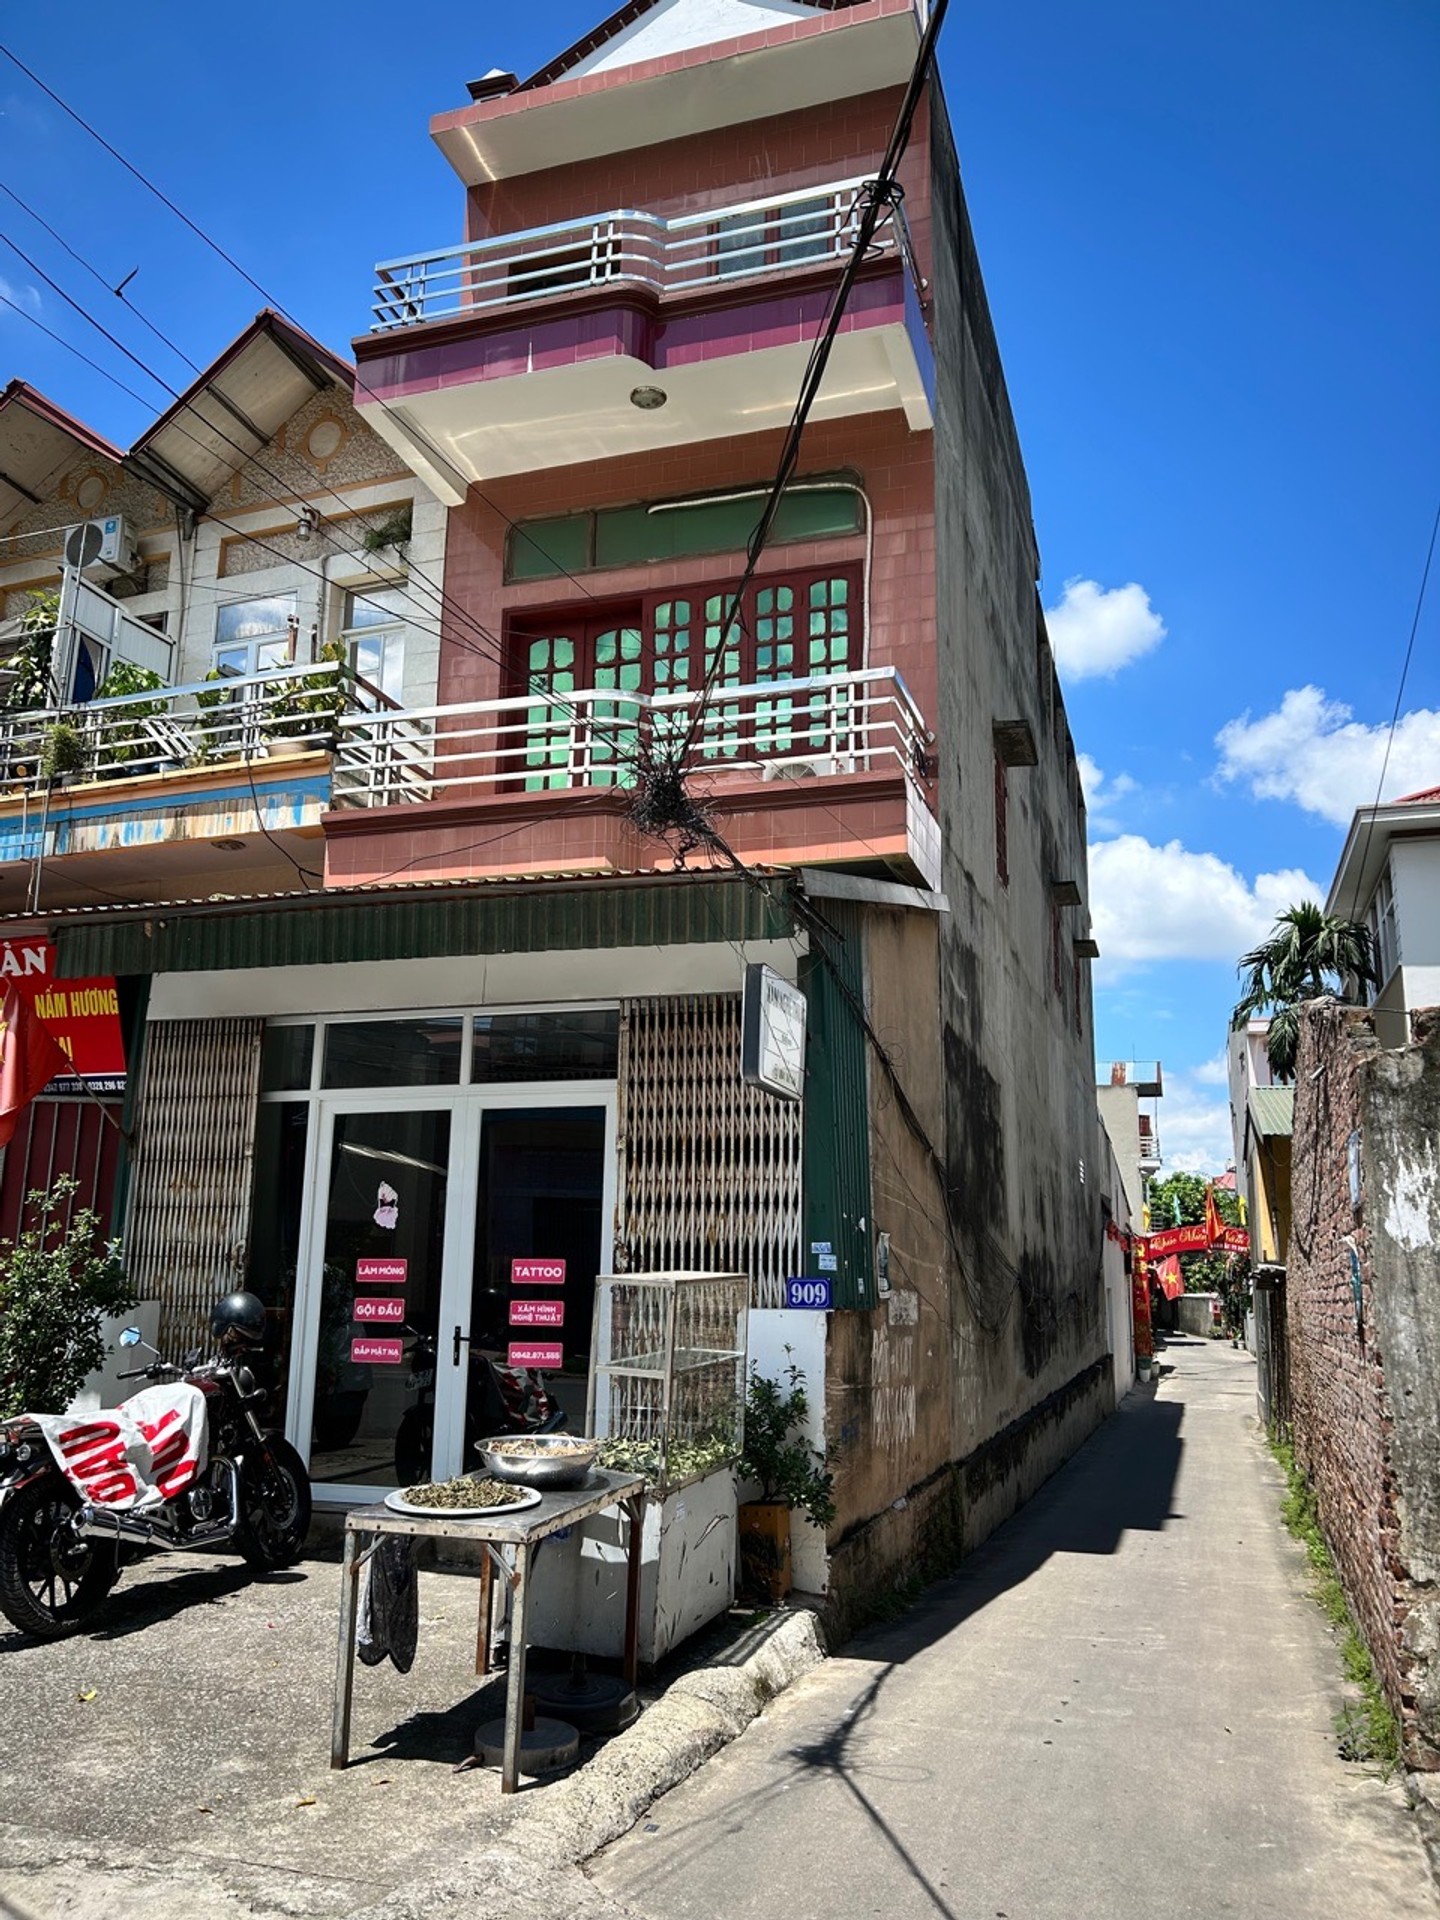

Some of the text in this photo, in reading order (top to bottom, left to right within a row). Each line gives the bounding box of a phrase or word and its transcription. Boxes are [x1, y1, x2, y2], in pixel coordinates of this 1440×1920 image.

[35, 984, 119, 1018] NẤM HƯƠNG
[378, 1265, 405, 1275] MÓNG
[514, 1266, 562, 1277] TATTOO
[791, 1283, 827, 1304] 909
[356, 1303, 375, 1317] GỘI
